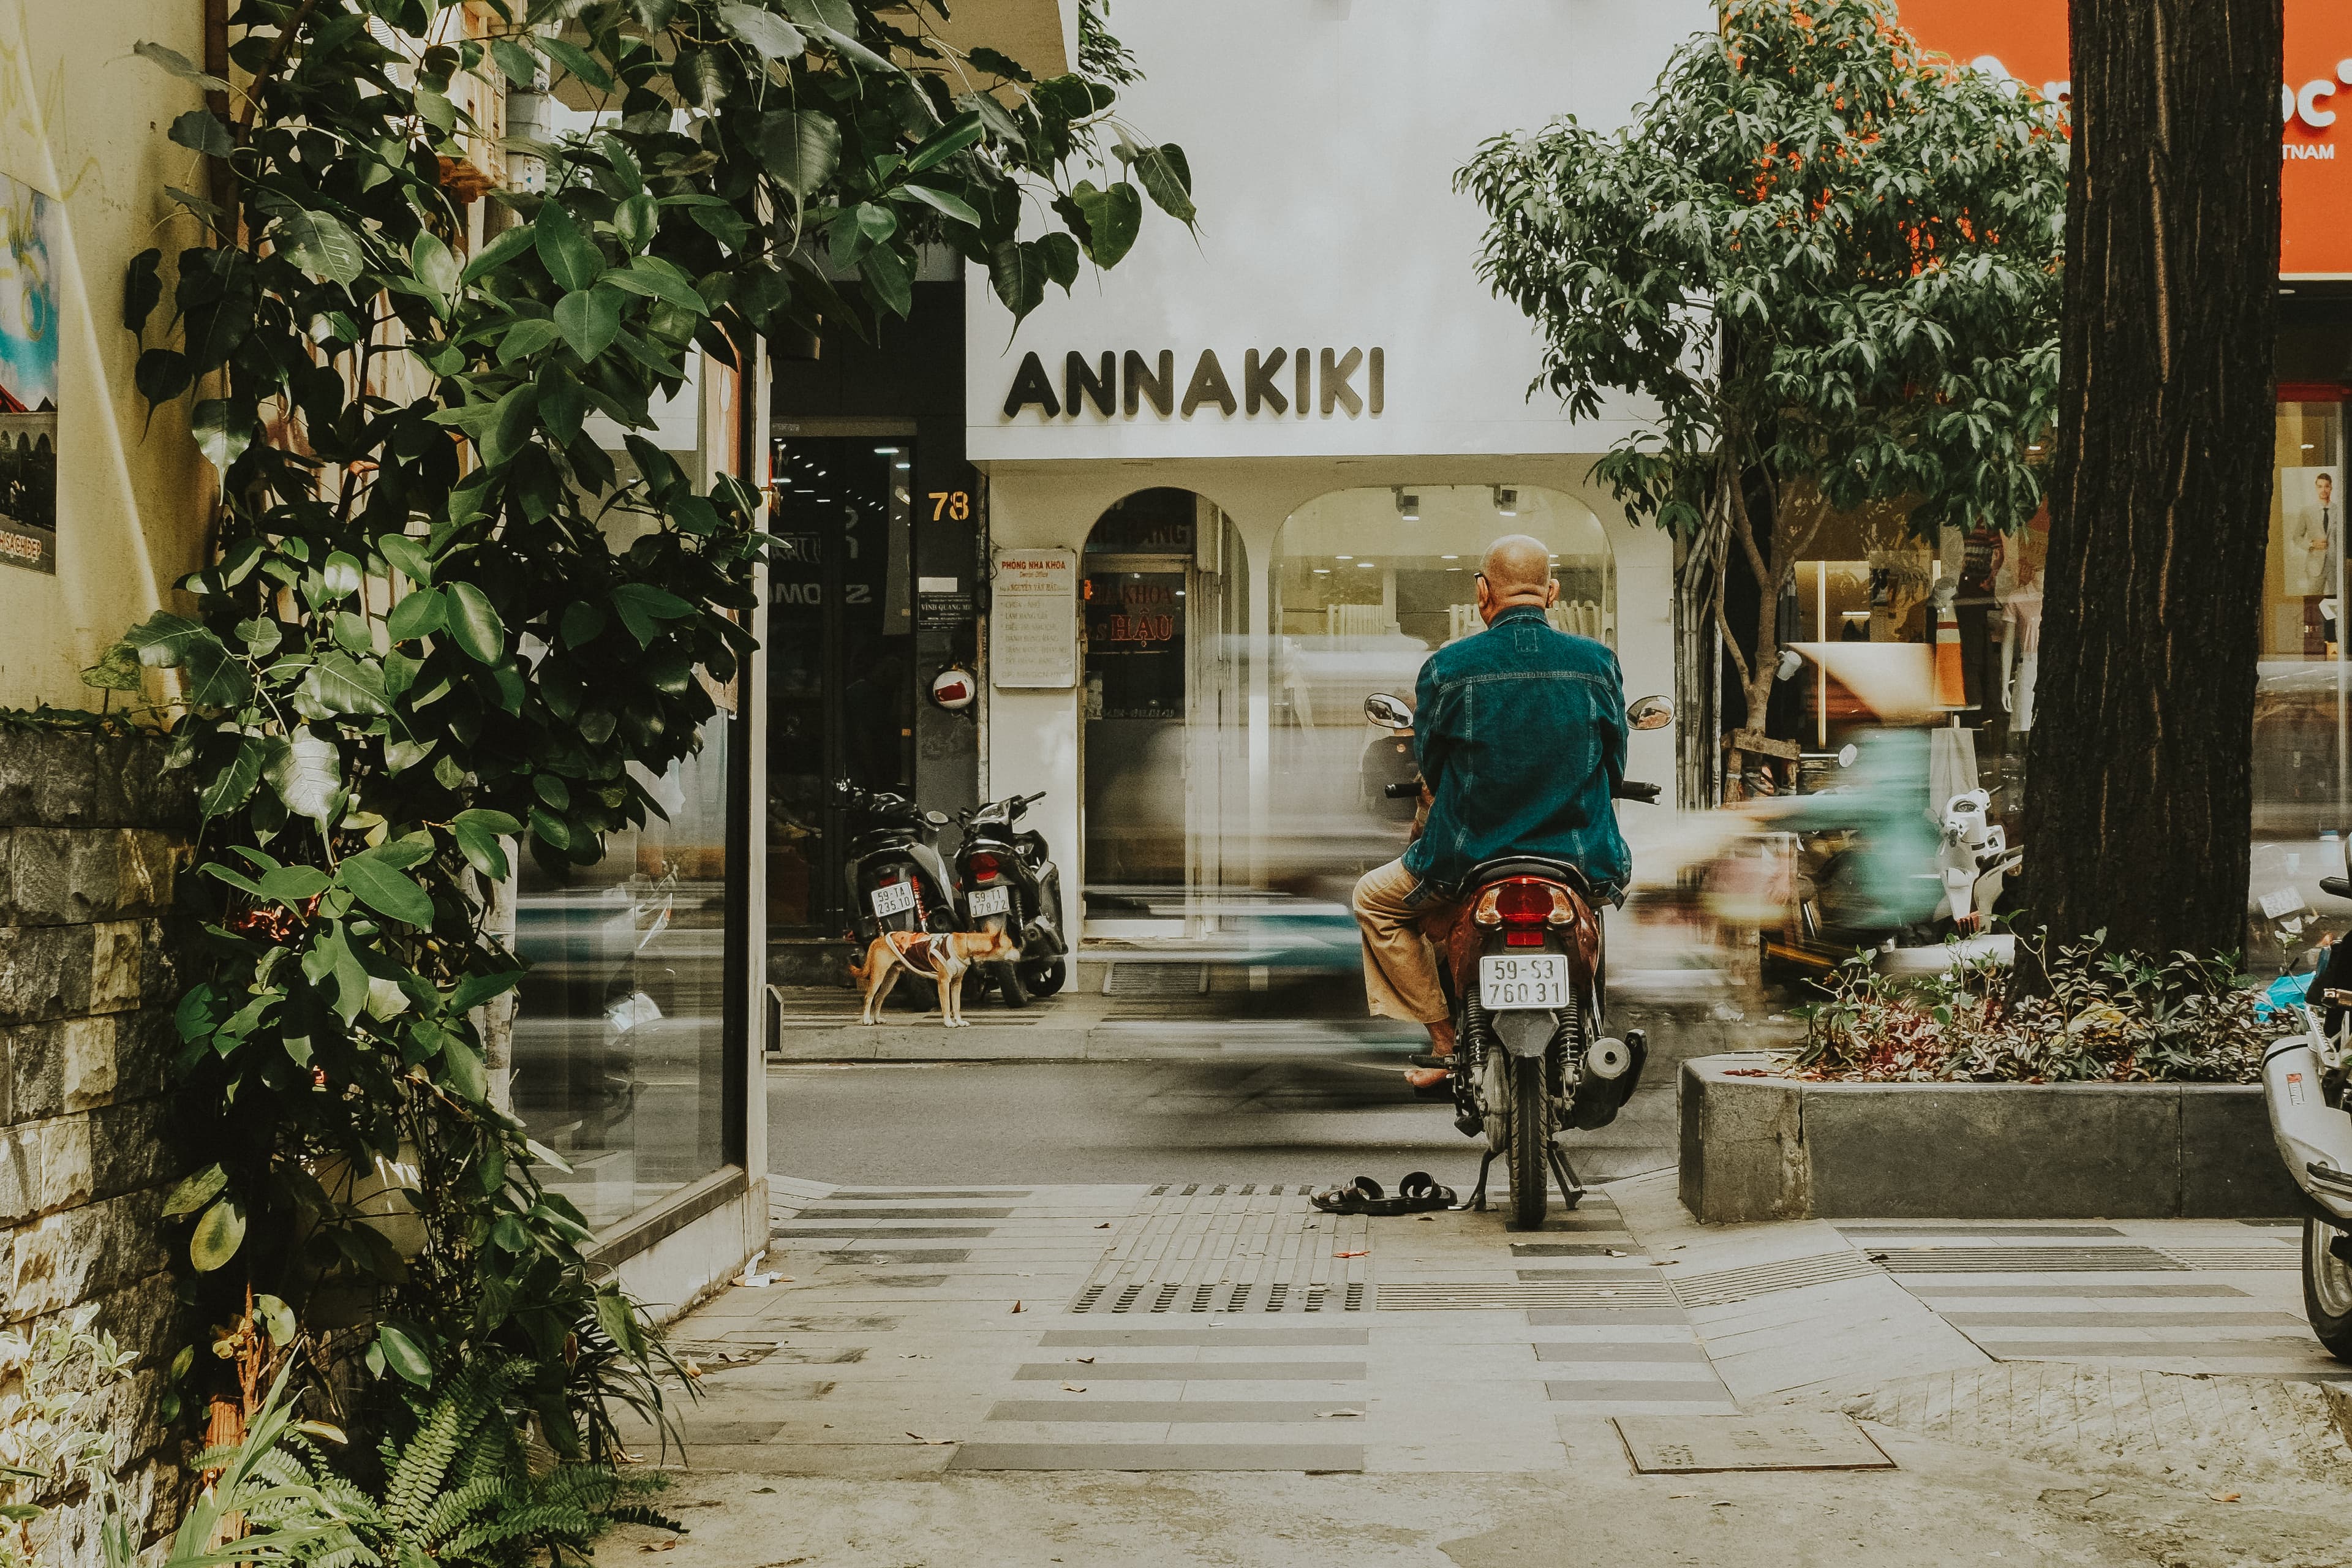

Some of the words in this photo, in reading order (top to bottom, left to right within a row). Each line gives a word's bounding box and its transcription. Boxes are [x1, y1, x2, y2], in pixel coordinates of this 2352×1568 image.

[1003, 346, 1384, 419] ANNAKIKI
[929, 491, 969, 521] 78
[1028, 560, 1044, 570] NHA
[1045, 560, 1066, 570] KHOA
[1494, 960, 1554, 981] 59-S3
[1489, 982, 1559, 1005] 760.31
